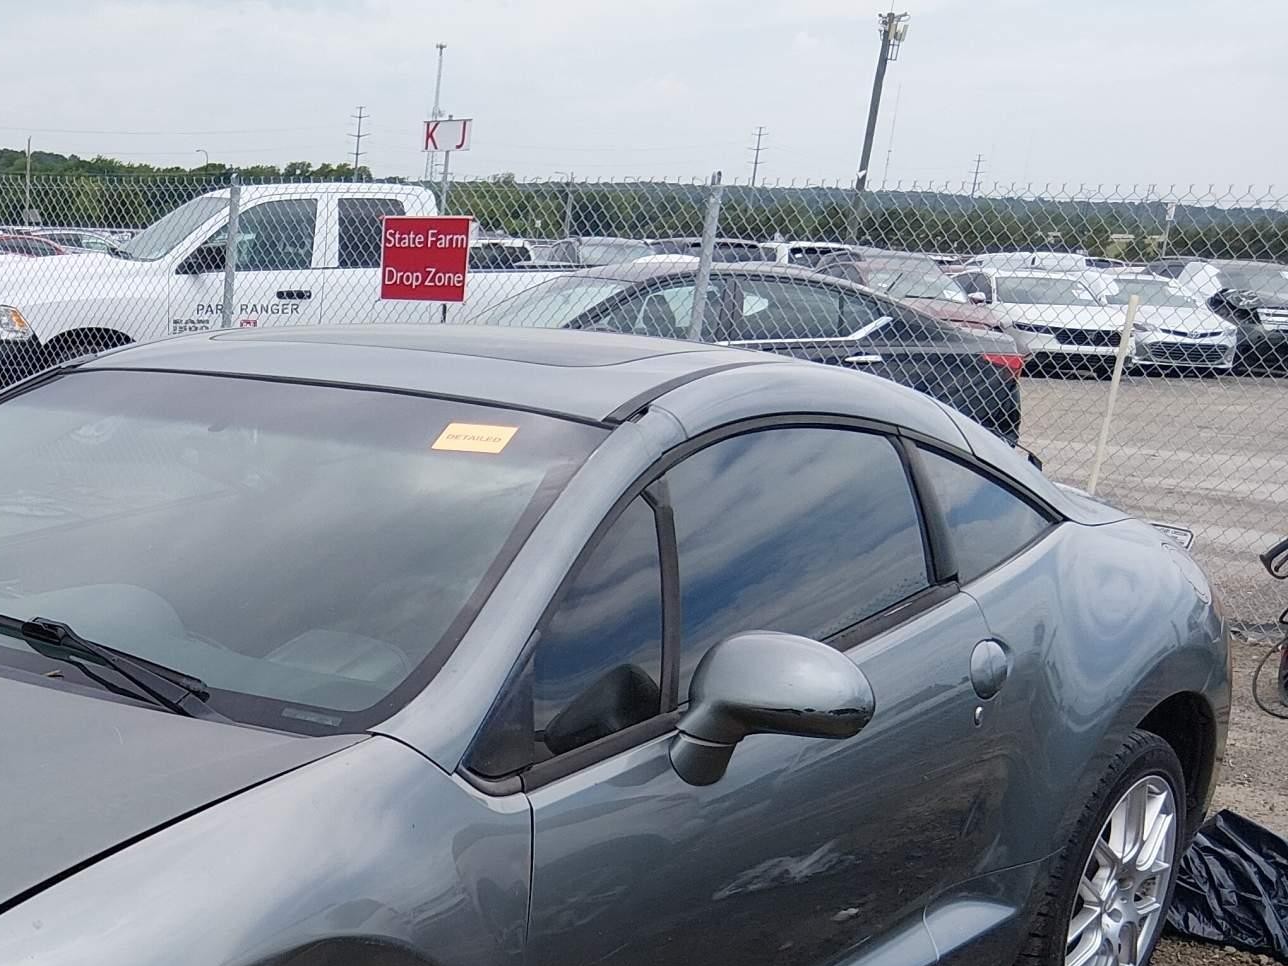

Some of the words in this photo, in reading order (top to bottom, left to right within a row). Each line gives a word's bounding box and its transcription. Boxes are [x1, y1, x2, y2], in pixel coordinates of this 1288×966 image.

[425, 121, 440, 150] K
[456, 120, 467, 149] J
[385, 229, 424, 248] State
[427, 229, 467, 248] Farm
[384, 266, 422, 289] Drop
[424, 268, 464, 287] Zone
[196, 303, 234, 316] PAR
[240, 303, 300, 315] RANGER
